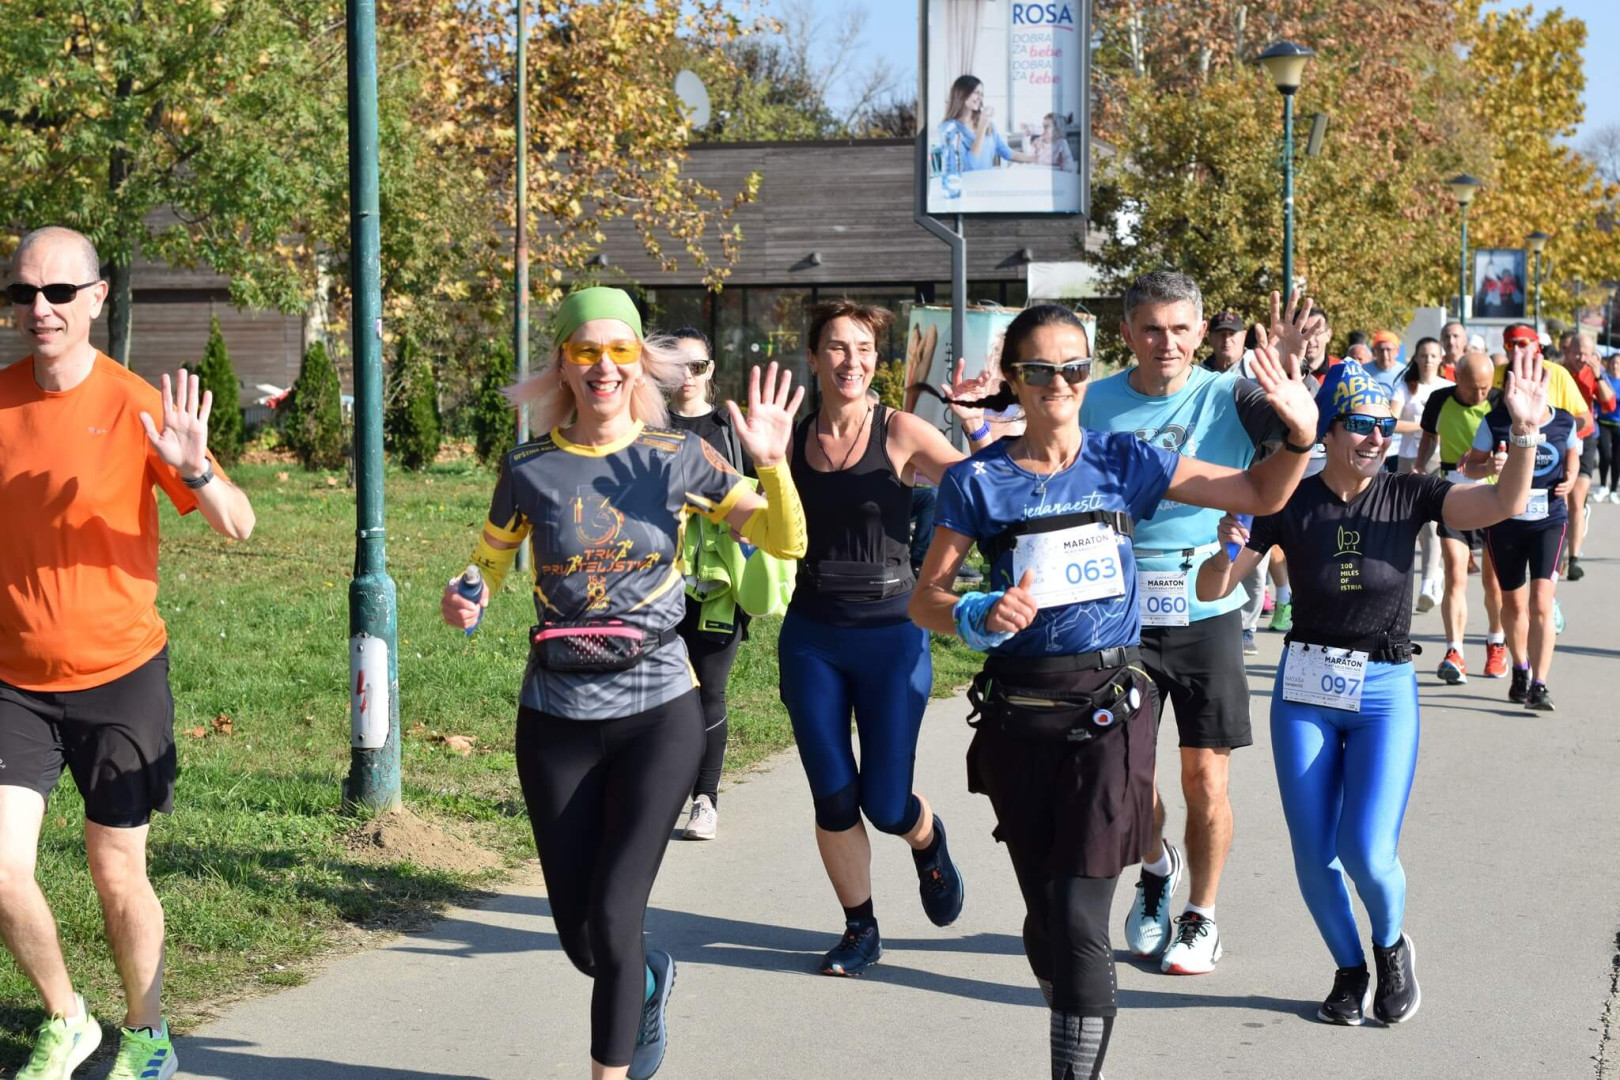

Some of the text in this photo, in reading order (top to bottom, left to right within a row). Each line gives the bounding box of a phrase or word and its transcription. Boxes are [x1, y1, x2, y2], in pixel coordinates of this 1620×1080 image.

[1013, 3, 1073, 24] ROSA
[1012, 33, 1052, 43] DOBRA
[1012, 44, 1063, 57] ZA bebe
[1012, 60, 1052, 70] DOBRA
[1012, 70, 1061, 84] ZA tebe
[1020, 491, 1107, 521] jedanaesti
[1063, 535, 1109, 550] MARATON
[1065, 556, 1118, 585] 063
[1147, 579, 1184, 587] MARATON
[1147, 596, 1187, 614] 060
[1324, 656, 1363, 668] MARATON
[1320, 674, 1361, 697] 097
